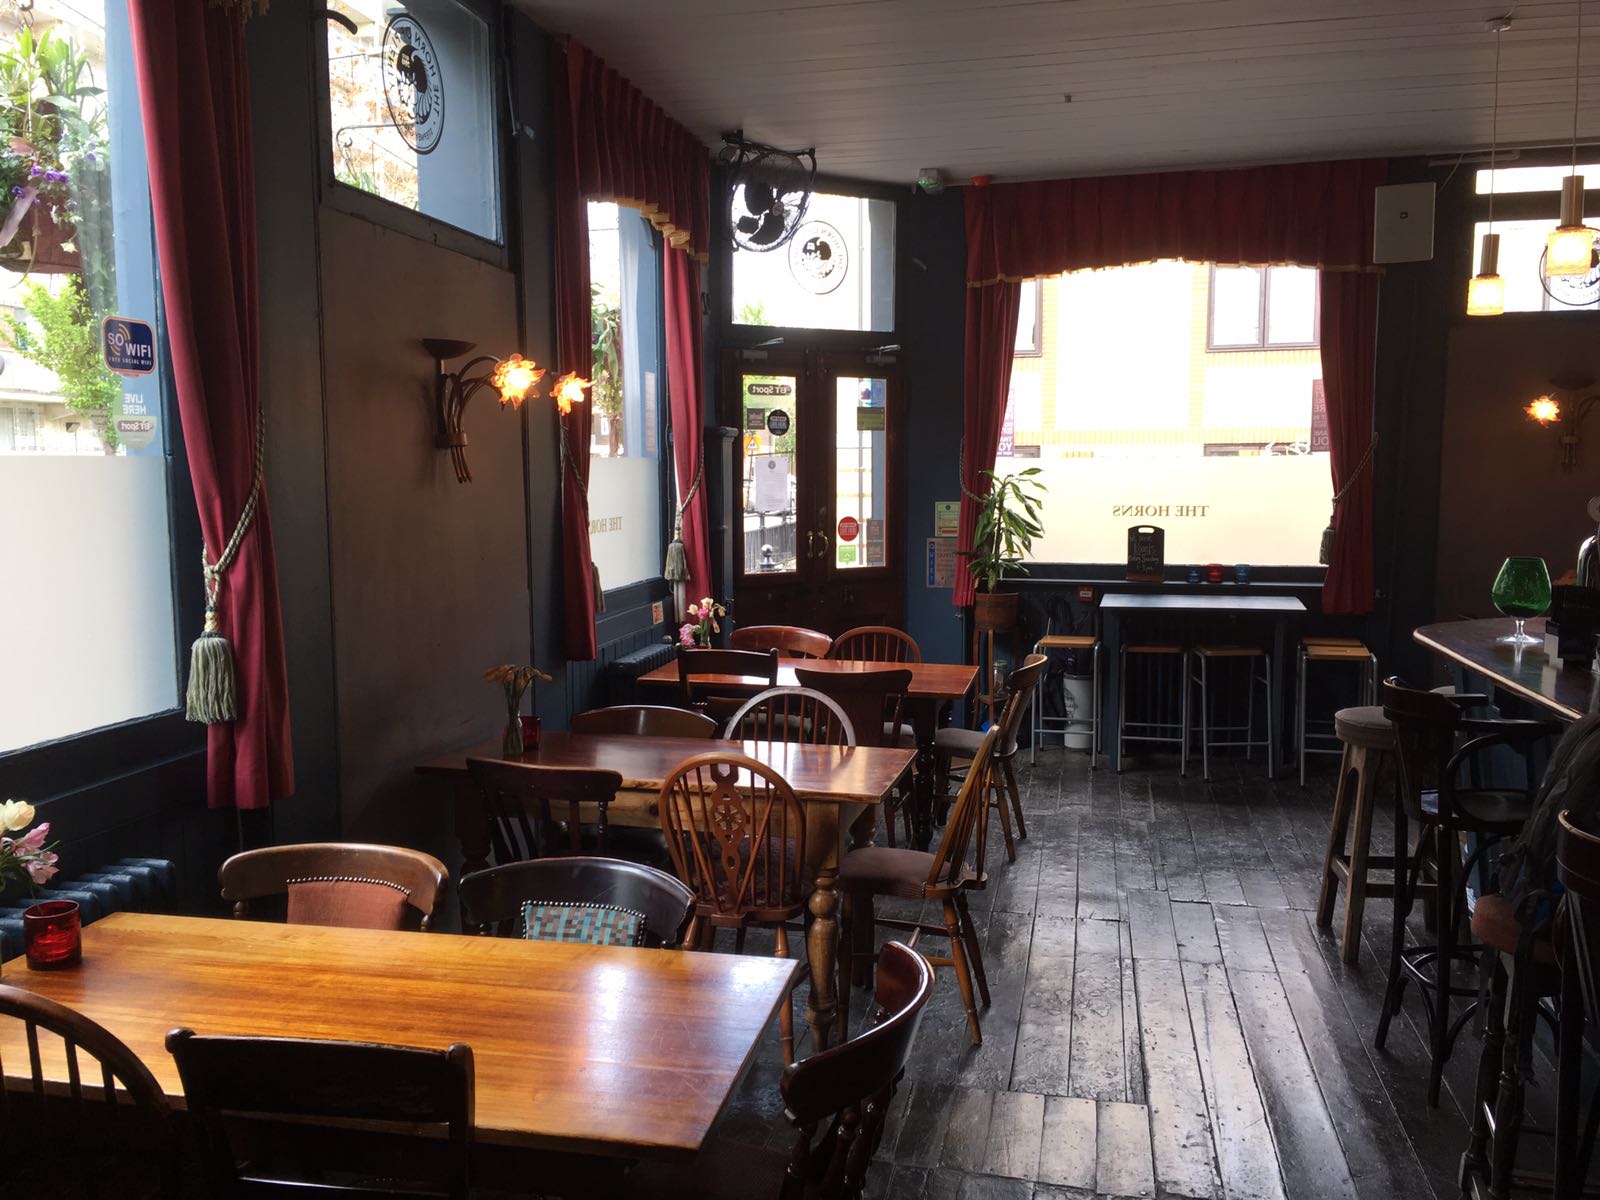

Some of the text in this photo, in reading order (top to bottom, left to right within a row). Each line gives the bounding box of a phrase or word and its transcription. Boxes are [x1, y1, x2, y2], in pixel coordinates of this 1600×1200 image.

[108, 332, 124, 346] SO
[125, 343, 151, 357] WIFI
[122, 357, 139, 365] SOCIAL
